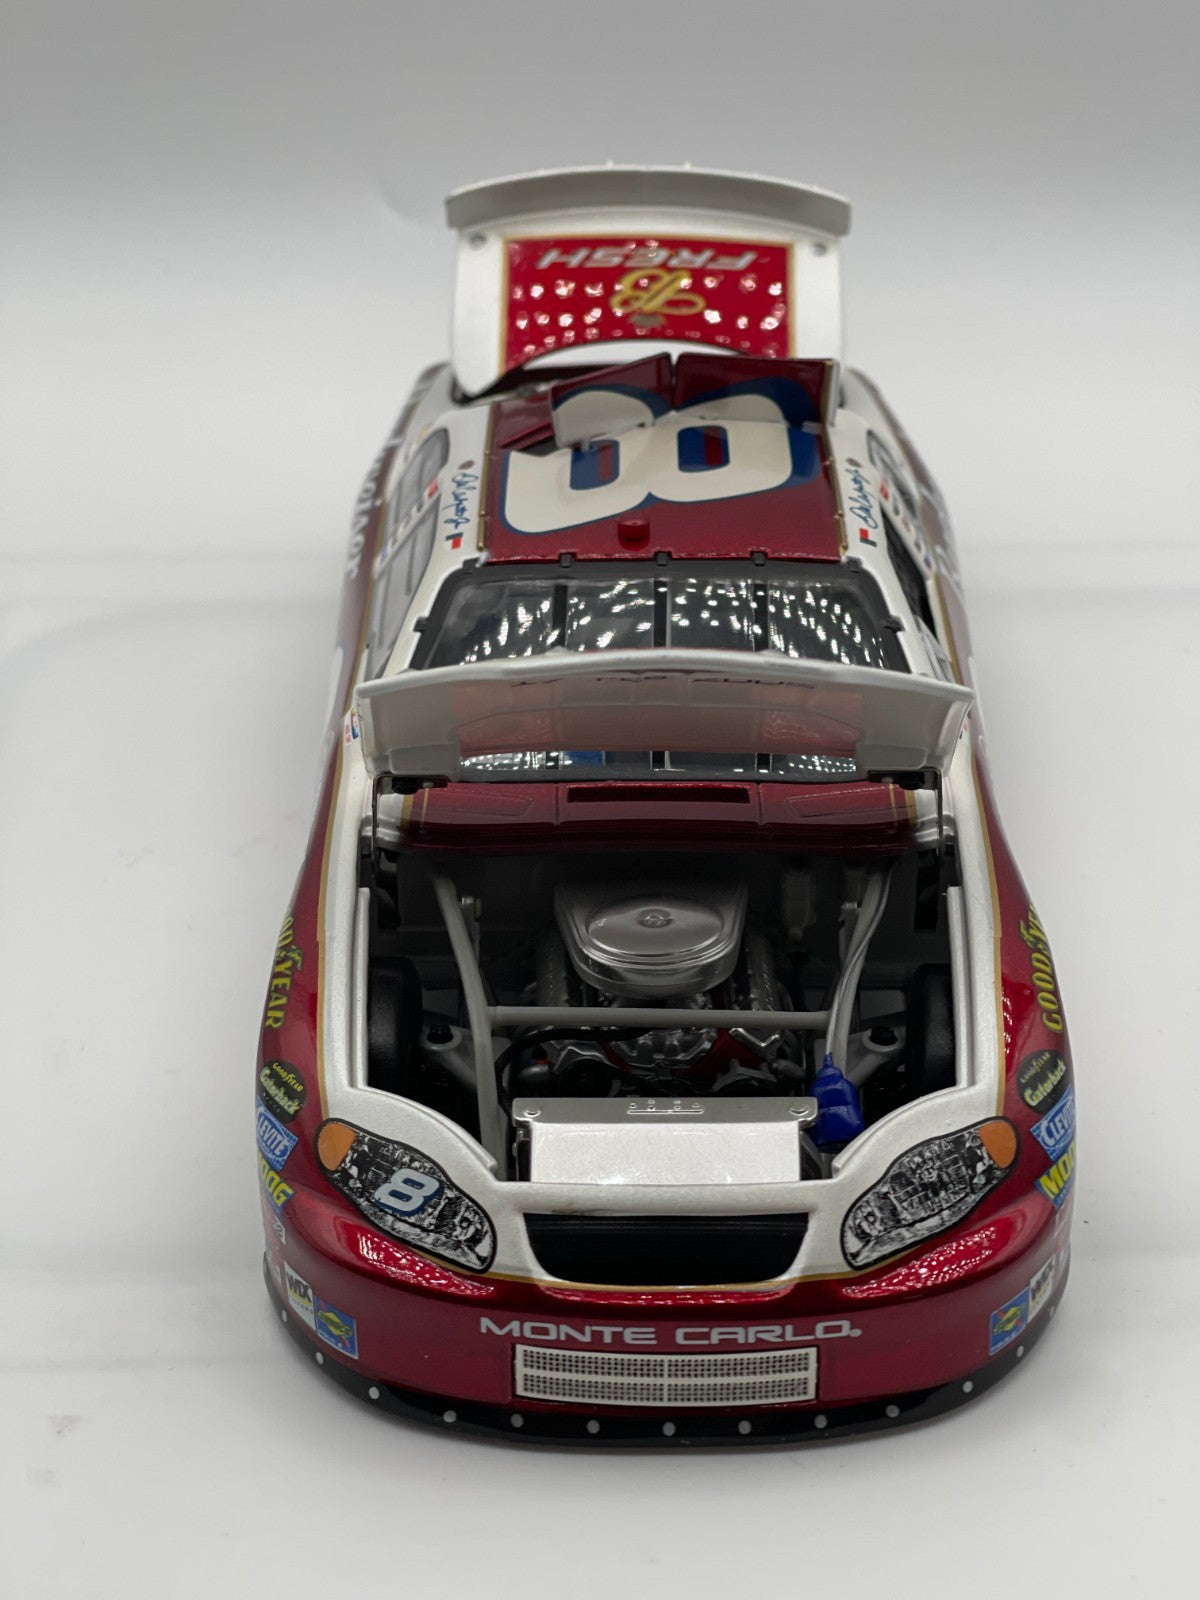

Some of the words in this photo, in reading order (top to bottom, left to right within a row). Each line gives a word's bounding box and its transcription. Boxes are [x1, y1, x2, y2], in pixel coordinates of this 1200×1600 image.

[535, 246, 760, 272] FRESH
[272, 1062, 304, 1093] GOODYEAR
[374, 1168, 445, 1217] 8
[480, 1317, 658, 1345] MONTE
[675, 1319, 854, 1346] CARLO
